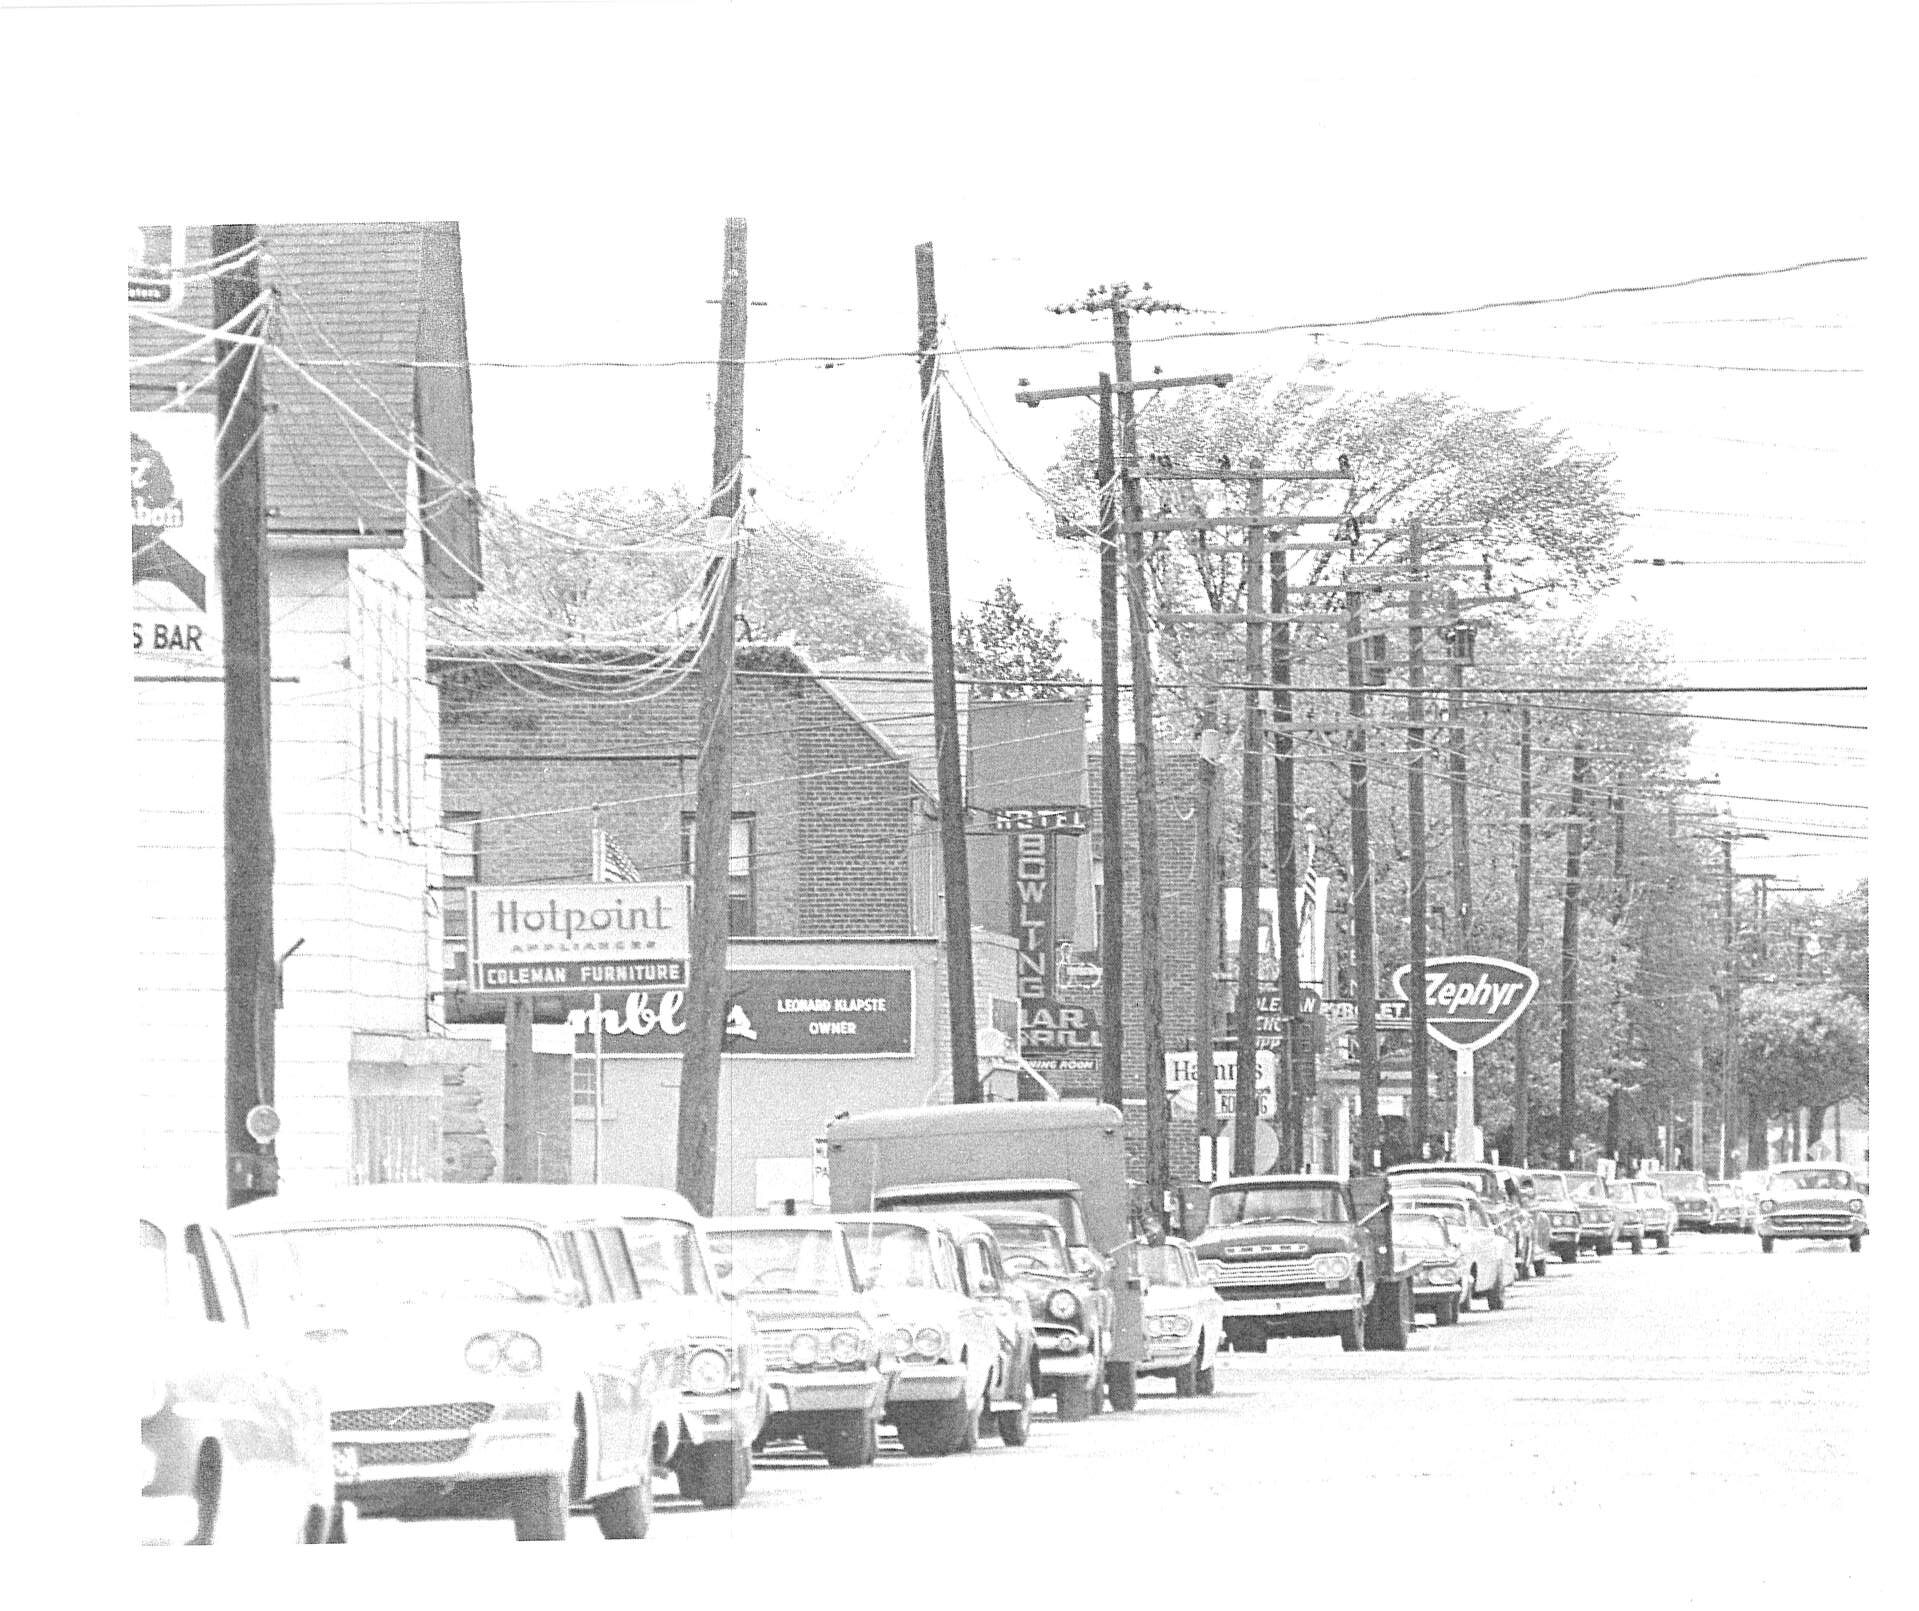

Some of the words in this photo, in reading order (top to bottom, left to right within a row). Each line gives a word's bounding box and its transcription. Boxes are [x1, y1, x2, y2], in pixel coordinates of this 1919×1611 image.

[153, 624, 202, 650] BAR
[491, 896, 672, 940] Hotpoint
[1017, 833, 1047, 999] BOWLING
[486, 967, 567, 985] COLEMAN
[580, 963, 681, 982] FURNITURE
[777, 999, 832, 1013] LEONARD
[834, 997, 888, 1013] KLAPSTE
[1424, 972, 1524, 1015] Zephyr
[808, 1022, 857, 1036] OWNER
[1060, 1060, 1095, 1069] ROOM
